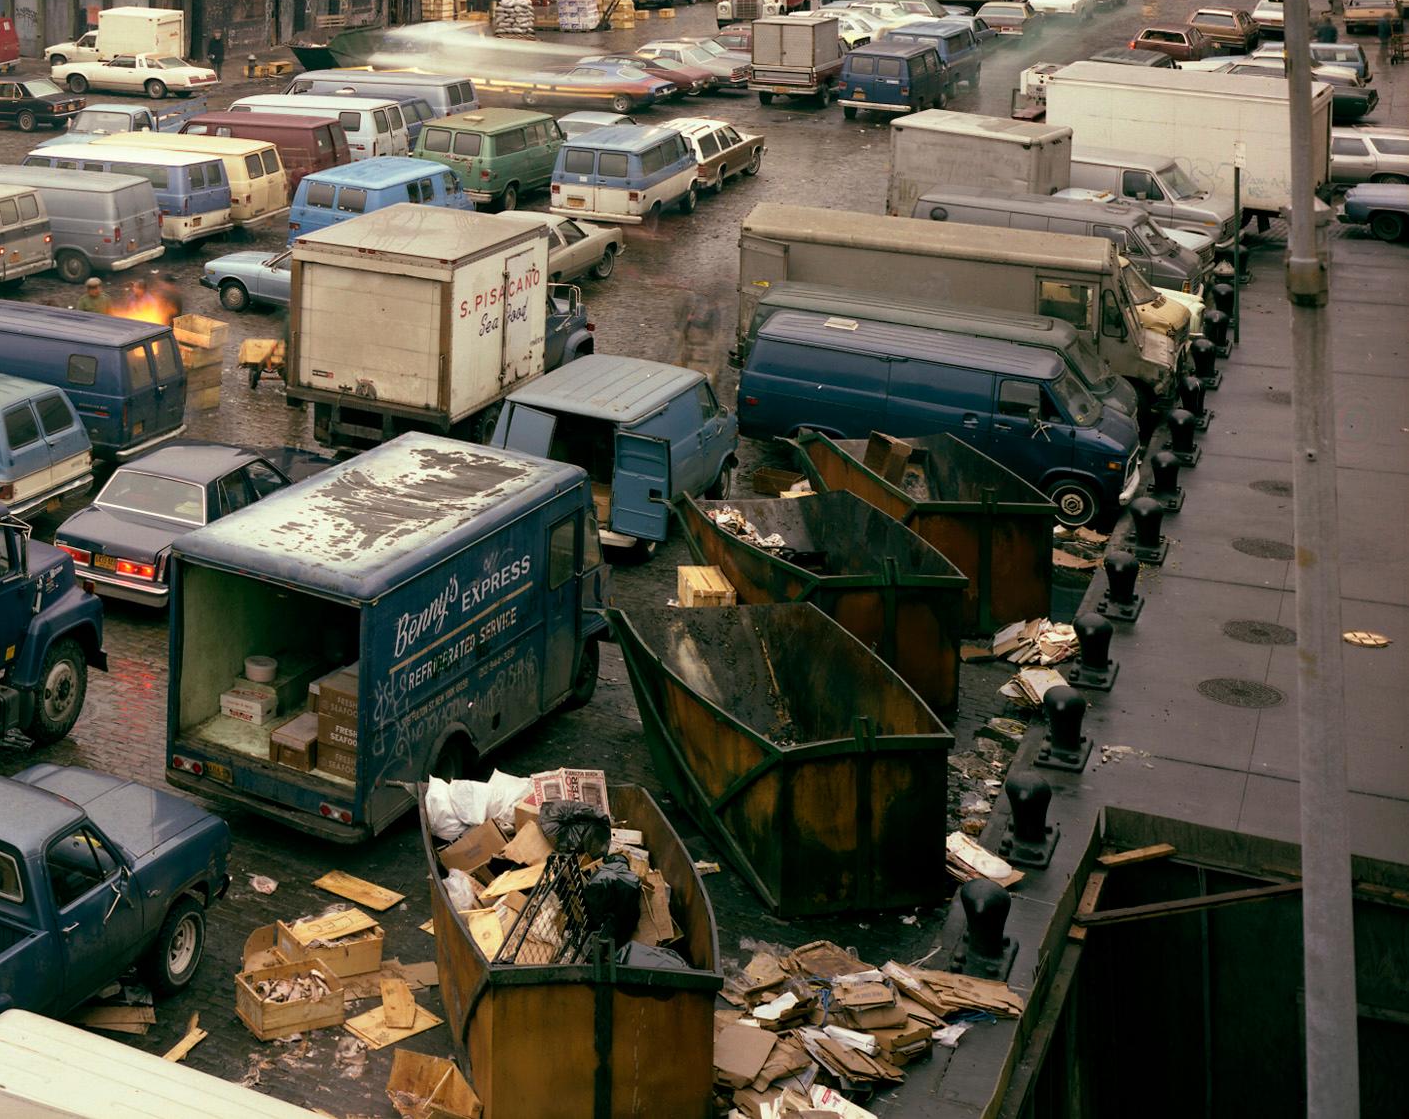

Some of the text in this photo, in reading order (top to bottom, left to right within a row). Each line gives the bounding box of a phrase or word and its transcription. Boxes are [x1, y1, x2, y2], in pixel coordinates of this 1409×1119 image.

[460, 269, 540, 318] S. PISACANO
[479, 312, 499, 337] Sea
[394, 555, 531, 658] Benny's EXPRESS
[479, 606, 517, 644] SERVICE
[330, 703, 358, 718] SEAFOO
[337, 696, 357, 709] FRESH
[330, 732, 358, 747] SEAFOO
[335, 725, 358, 739] FRESH
[328, 760, 356, 776] SEAFOO
